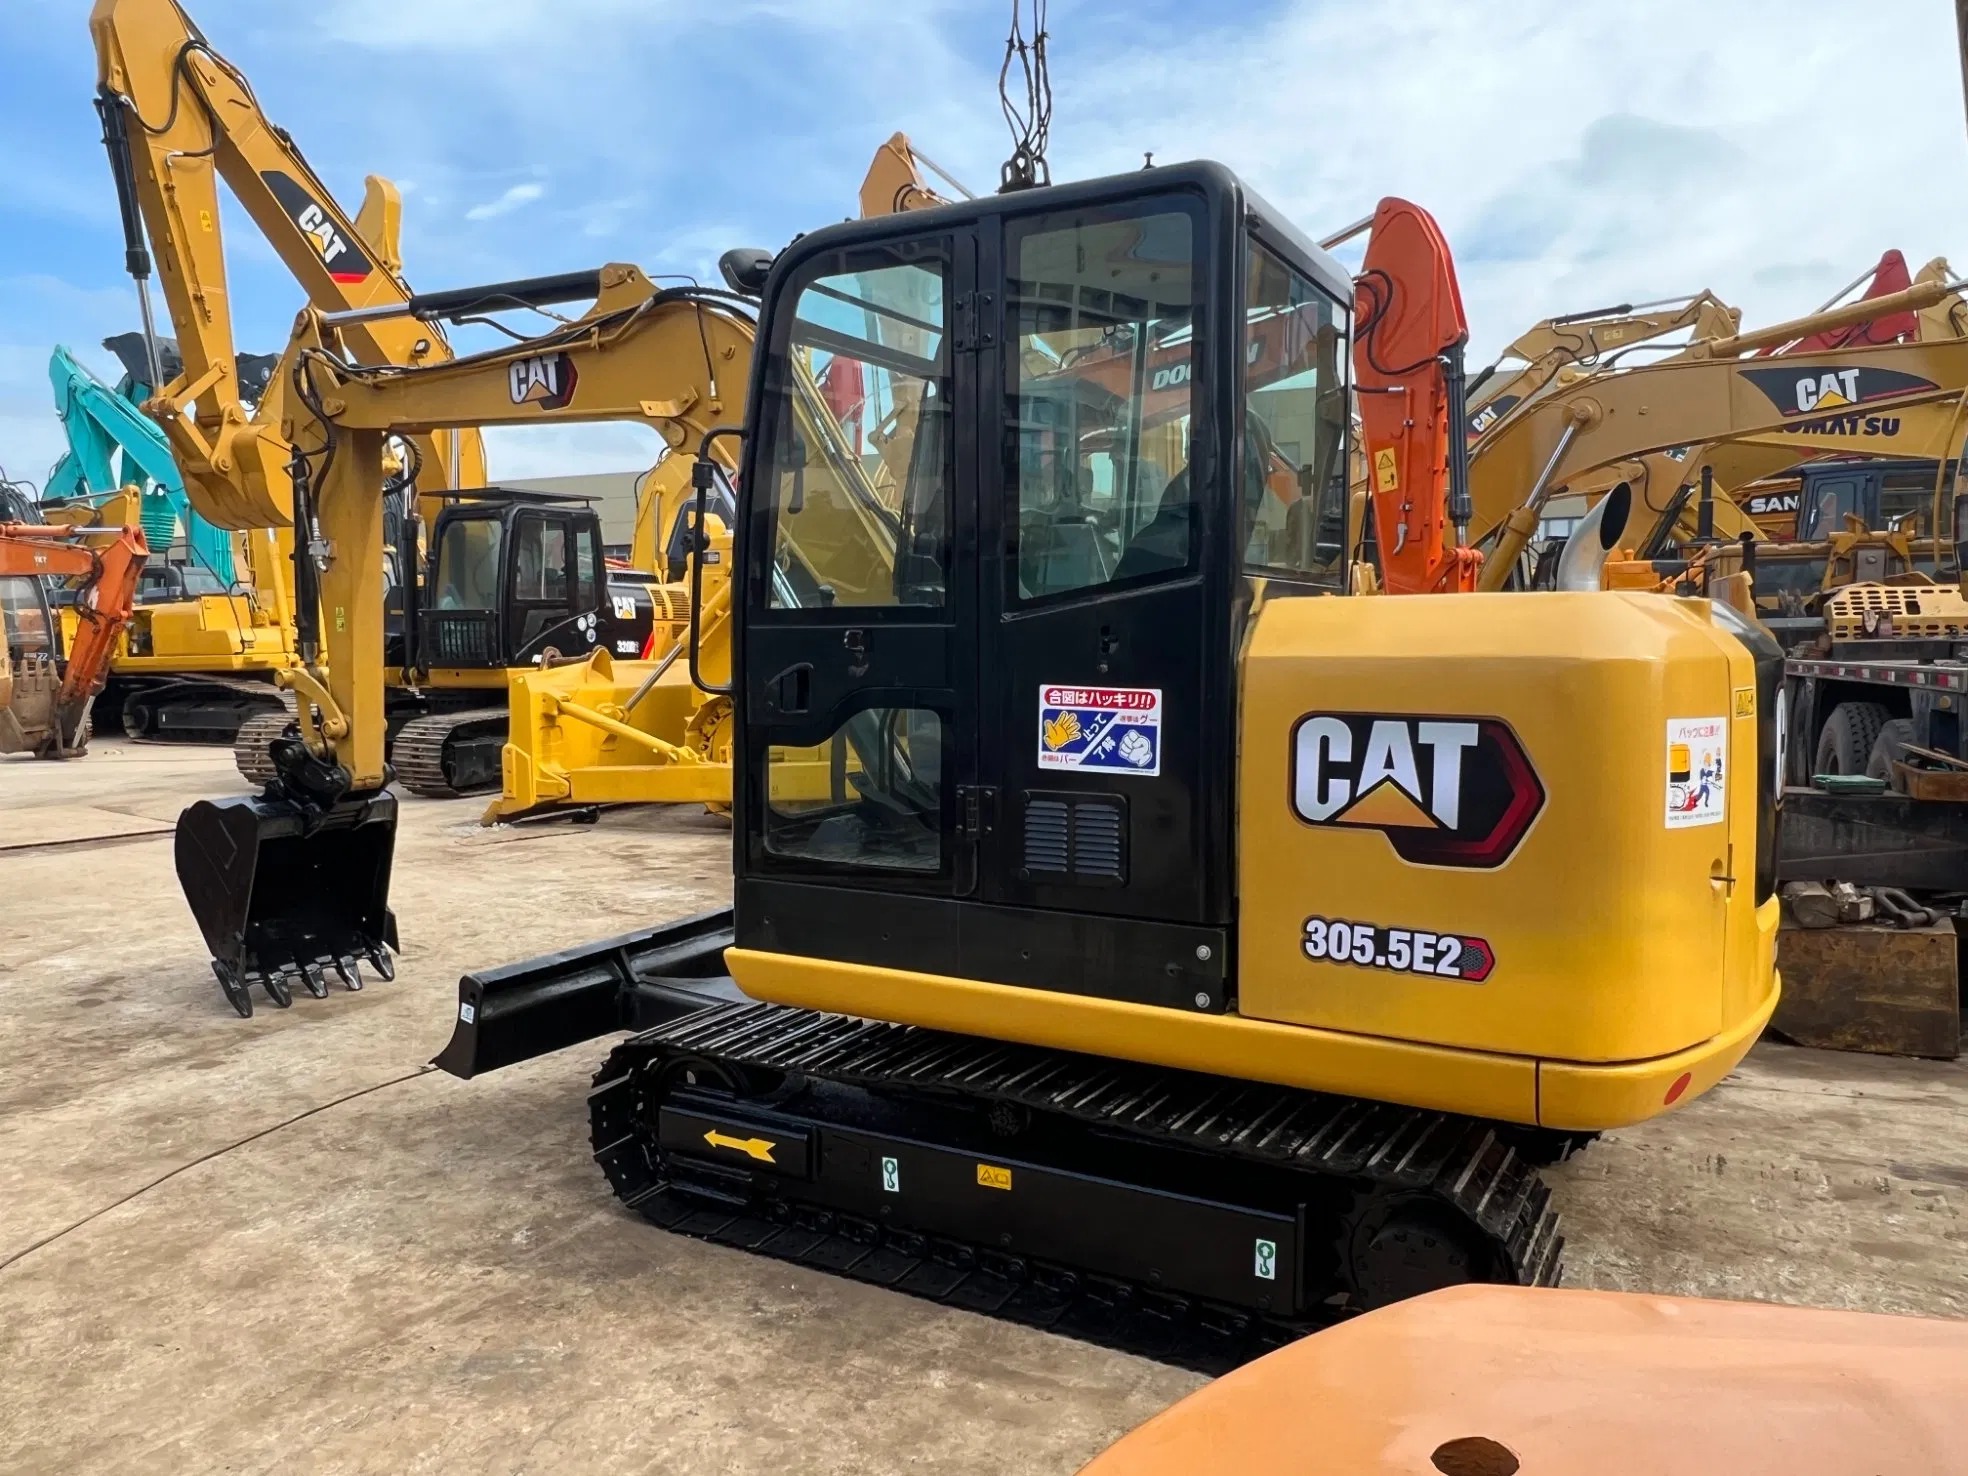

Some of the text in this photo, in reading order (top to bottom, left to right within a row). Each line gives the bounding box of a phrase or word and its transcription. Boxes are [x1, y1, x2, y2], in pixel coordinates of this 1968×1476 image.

[299, 204, 347, 264] CAT
[510, 352, 559, 403] CAT
[1796, 368, 1860, 412] CAT
[1472, 406, 1498, 432] CAT
[612, 596, 636, 619] CAT
[1295, 716, 1479, 831] CAT
[1304, 919, 1462, 977] 305.5E2
